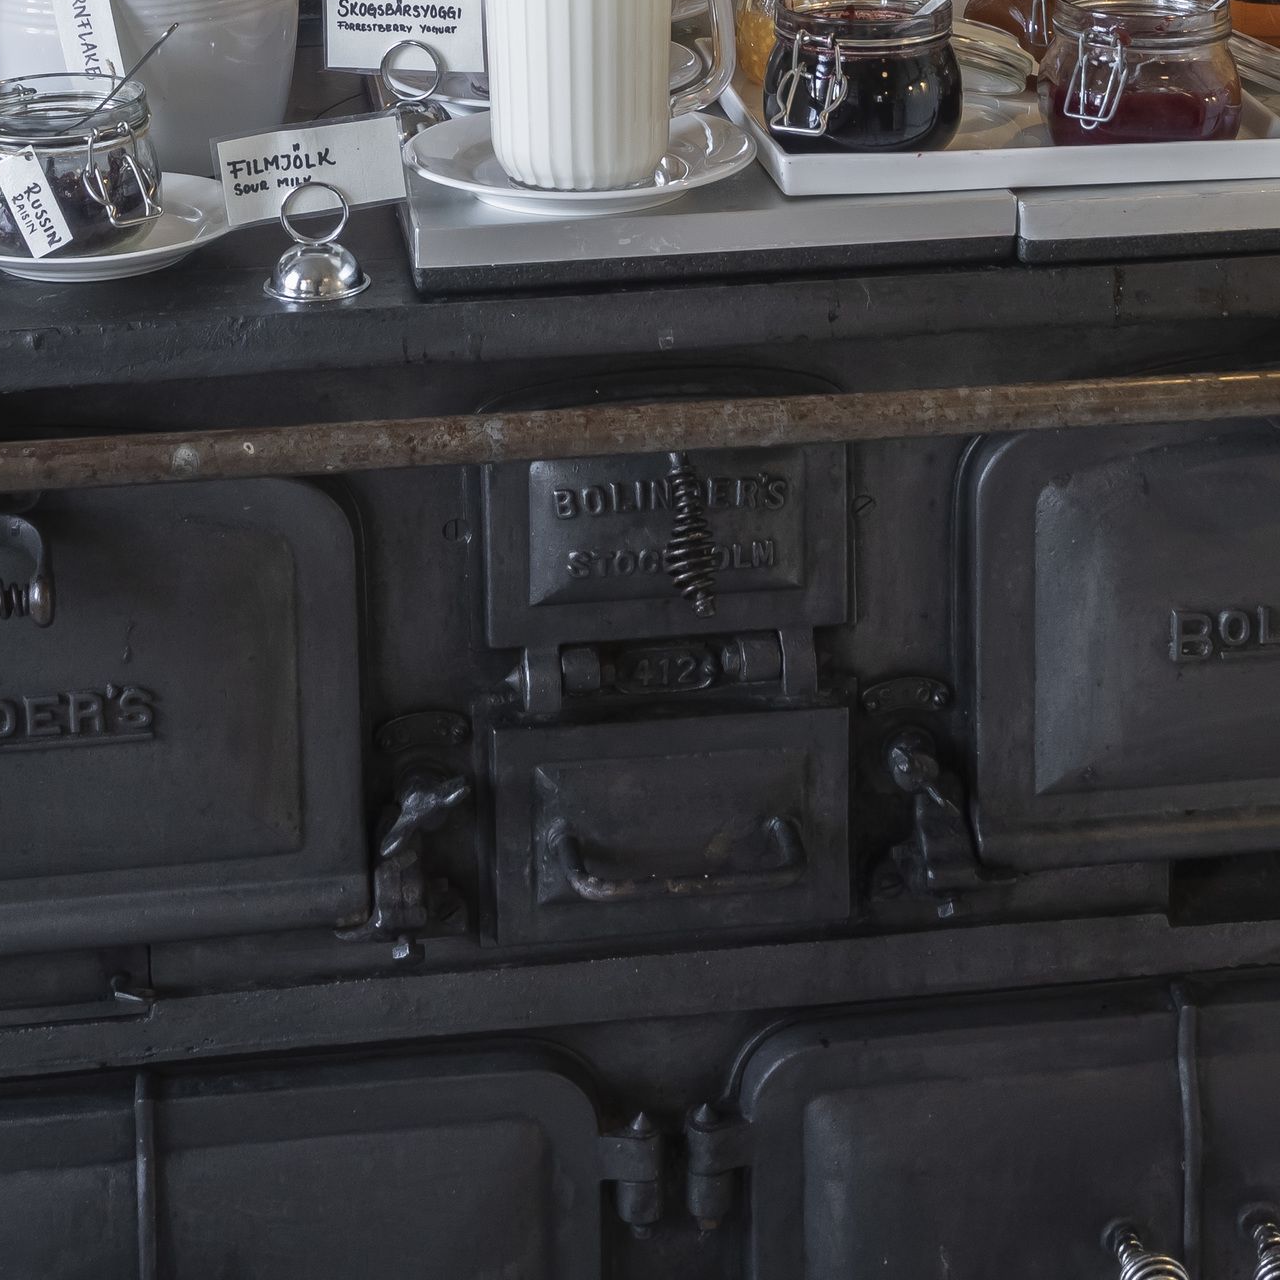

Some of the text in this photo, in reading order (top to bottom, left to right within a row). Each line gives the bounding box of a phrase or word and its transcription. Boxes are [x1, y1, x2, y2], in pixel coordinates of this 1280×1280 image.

[337, 21, 458, 35] FORRESTBERRY YOGURT
[226, 142, 337, 179] FILMJÖLK
[233, 175, 312, 196] SOUR MILK
[11, 193, 38, 235] RAISIN
[23, 181, 63, 248] RUSSIN
[567, 539, 776, 578] STOCOLM
